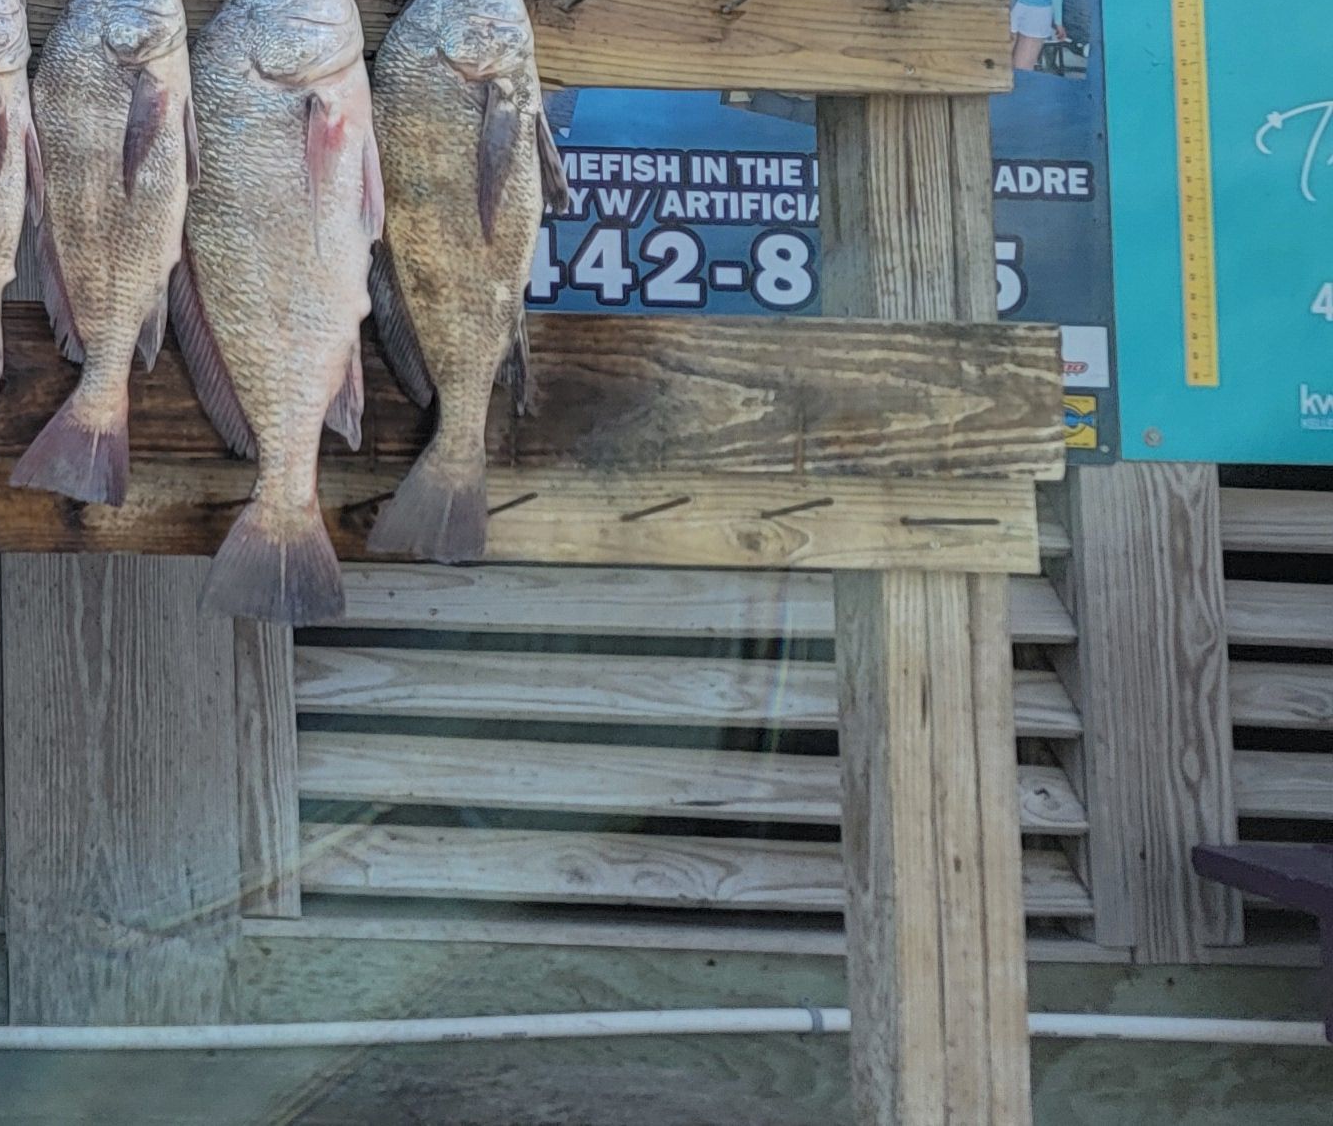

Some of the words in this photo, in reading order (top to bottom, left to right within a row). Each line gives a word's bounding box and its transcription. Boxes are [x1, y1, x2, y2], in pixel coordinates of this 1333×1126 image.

[691, 156, 728, 185] IN
[736, 157, 804, 187] THE
[993, 165, 1089, 195] ADRE
